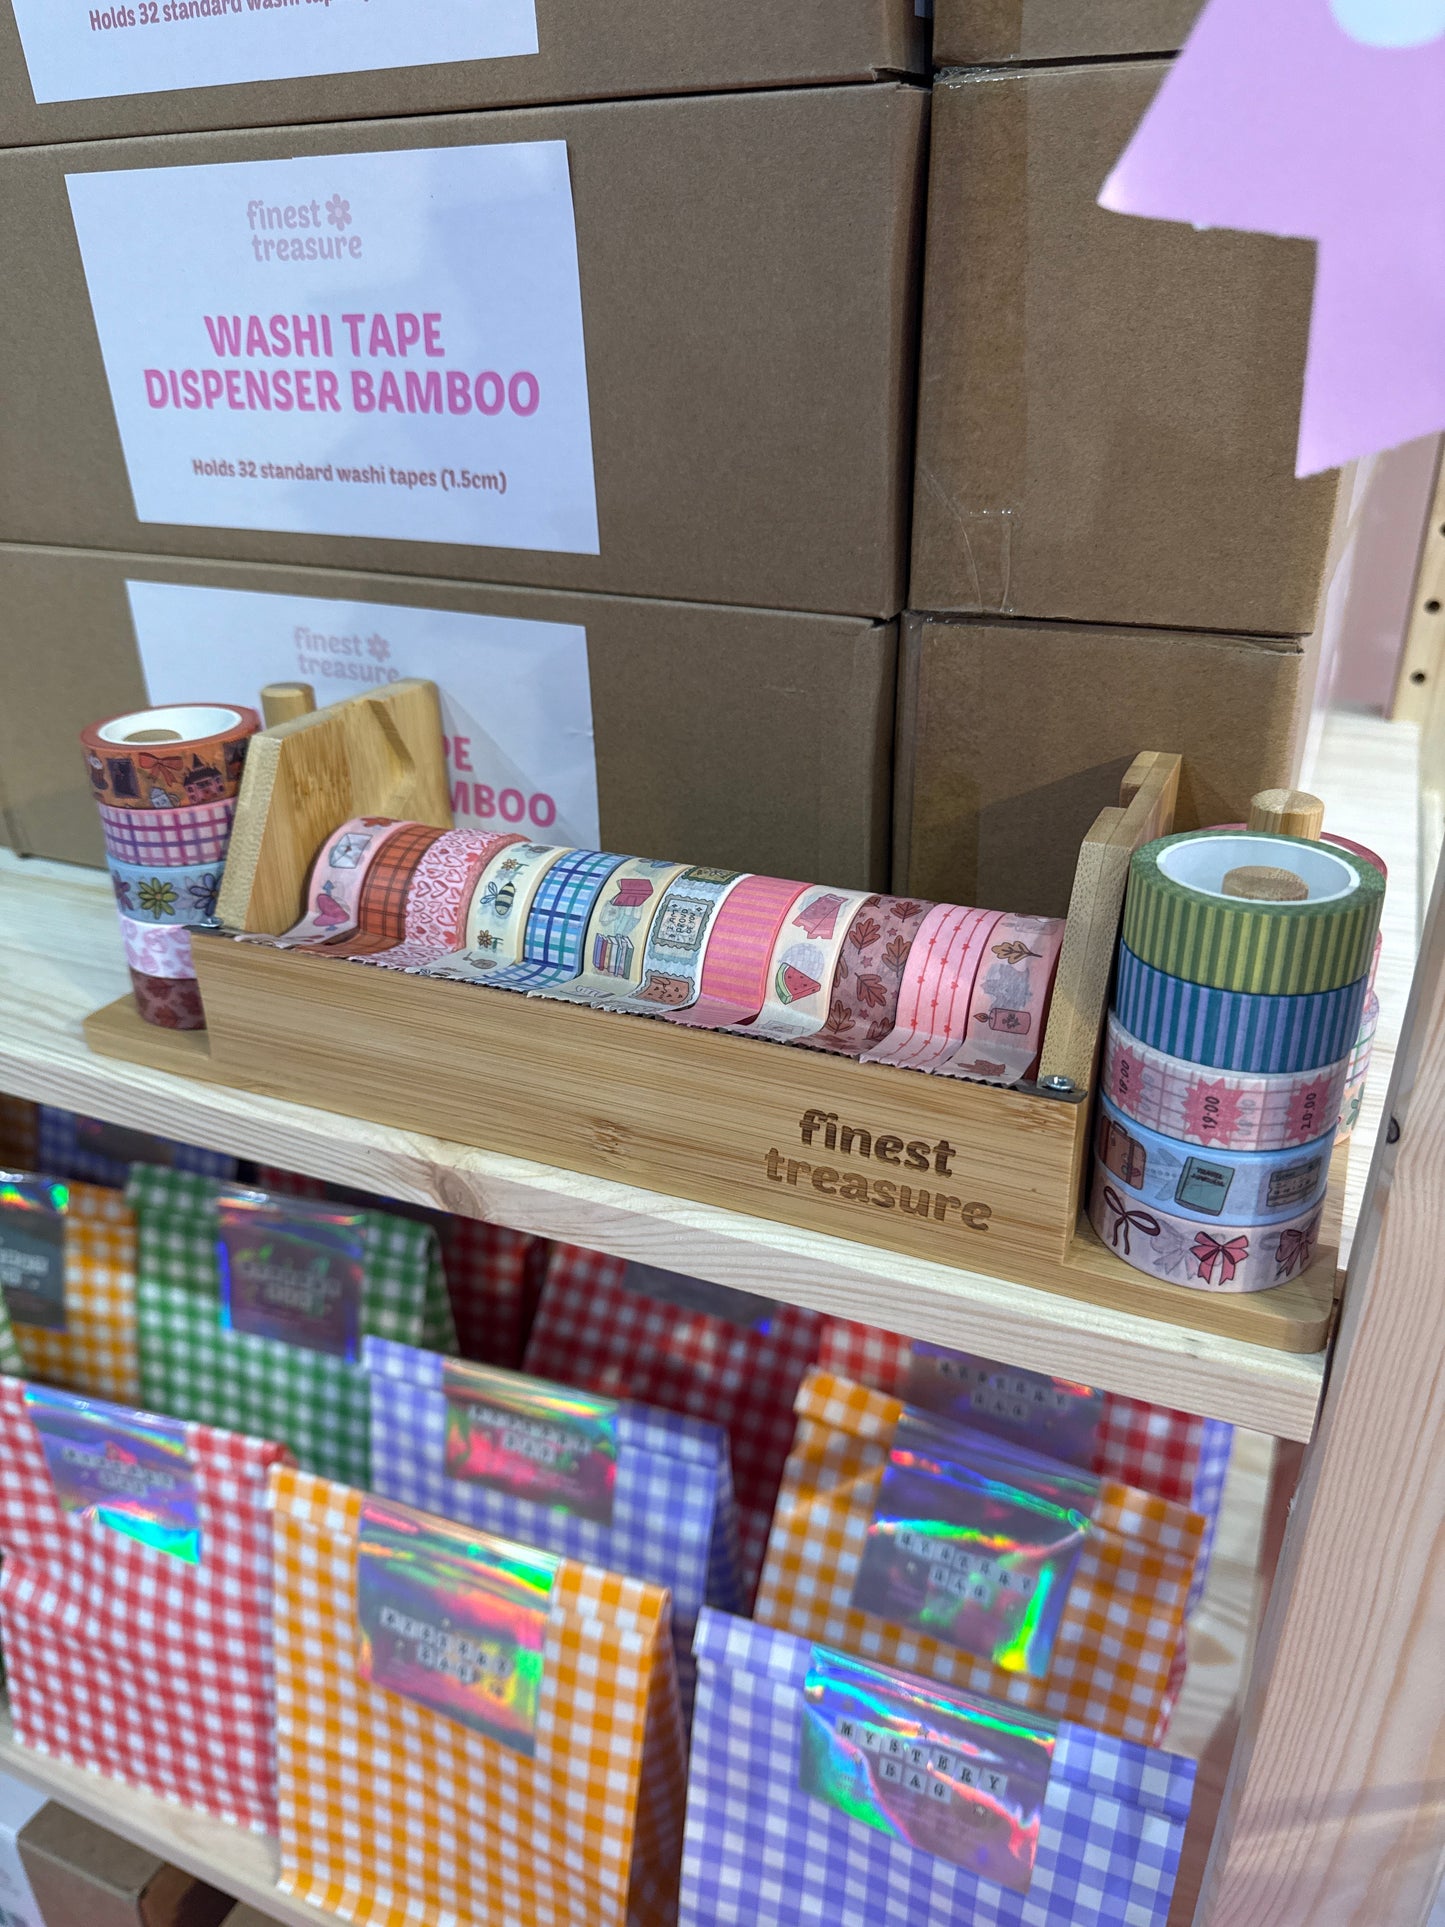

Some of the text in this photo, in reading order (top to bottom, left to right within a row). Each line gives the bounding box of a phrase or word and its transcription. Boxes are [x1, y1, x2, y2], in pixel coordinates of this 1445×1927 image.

[89, 7, 136, 31] Holds
[139, 1, 160, 25] 32
[246, 199, 322, 231] finest
[251, 233, 363, 263] treasure
[203, 312, 446, 358] WASHI TAPE
[143, 369, 541, 418] DISPENSER BAMBOO
[192, 459, 508, 494] Holds 32 standard washi tapes (1.5cm)
[293, 624, 363, 657] finest
[297, 653, 400, 684] treasure
[1202, 1095, 1221, 1131] 19:00
[799, 1108, 957, 1178] finest
[764, 1147, 993, 1232] treasure
[884, 1762, 946, 1799] BAG
